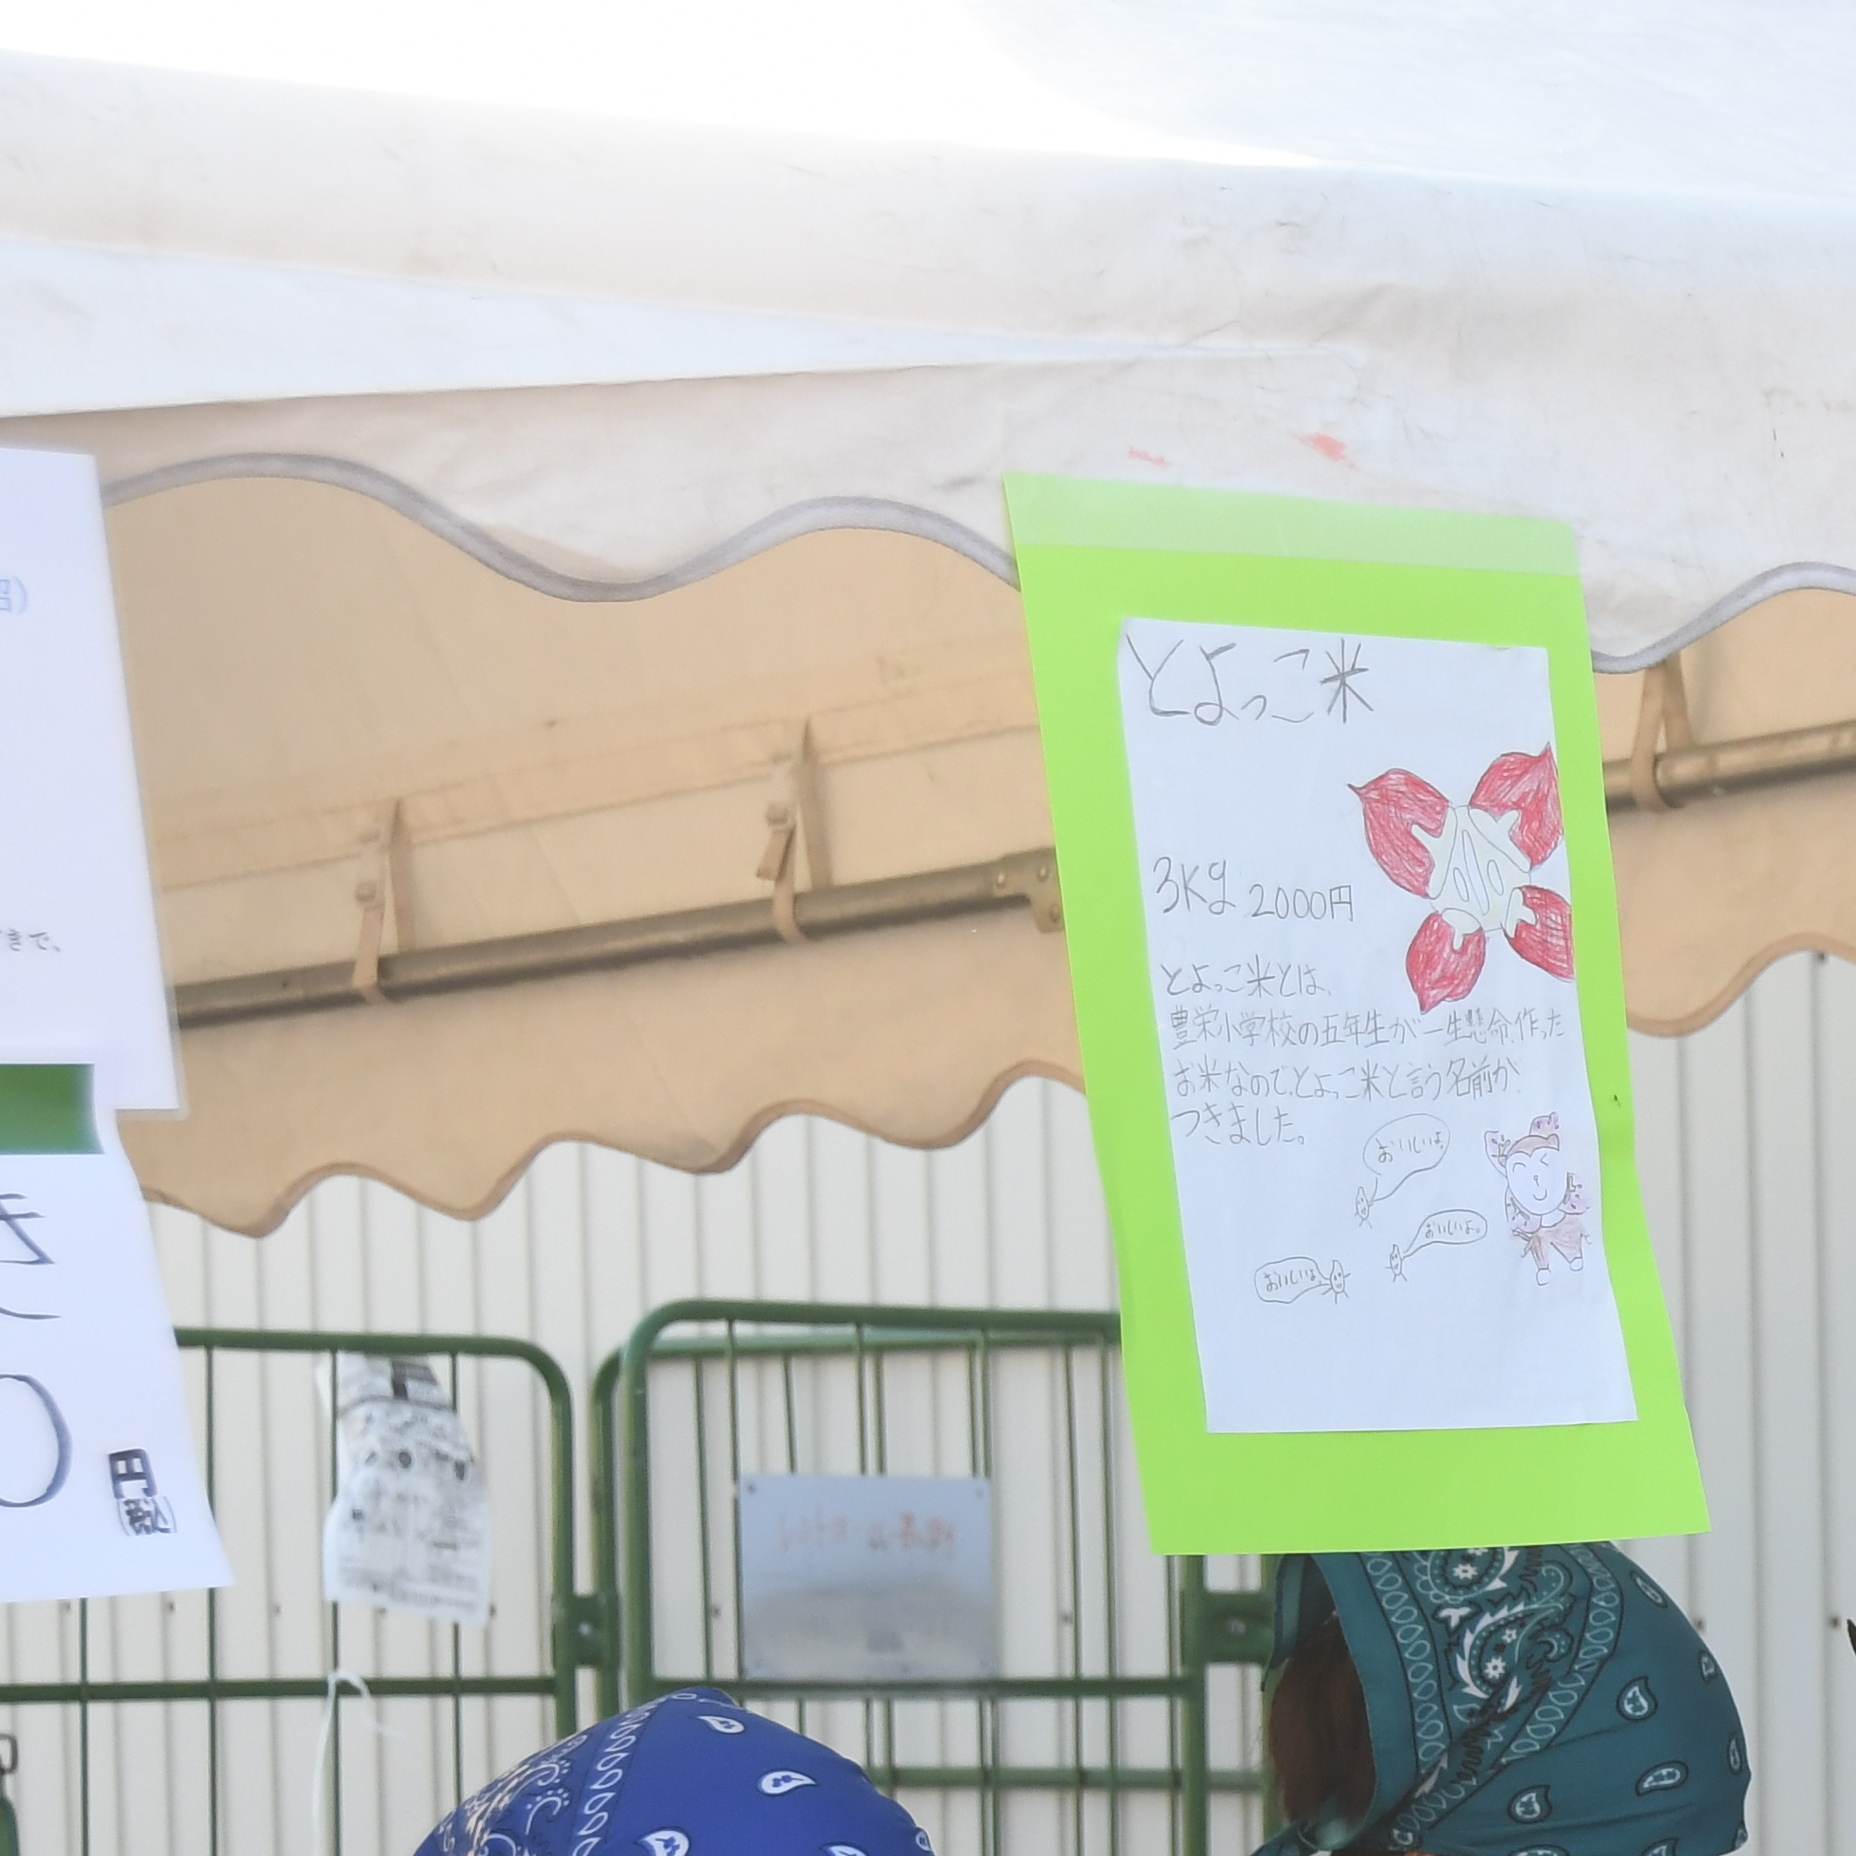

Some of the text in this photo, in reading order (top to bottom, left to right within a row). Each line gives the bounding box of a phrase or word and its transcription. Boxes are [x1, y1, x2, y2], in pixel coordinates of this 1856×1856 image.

[1126, 634, 1373, 725] とよっこ米
[1250, 884, 1352, 922] 2000円
[1171, 1103, 1305, 1147] つきました。
